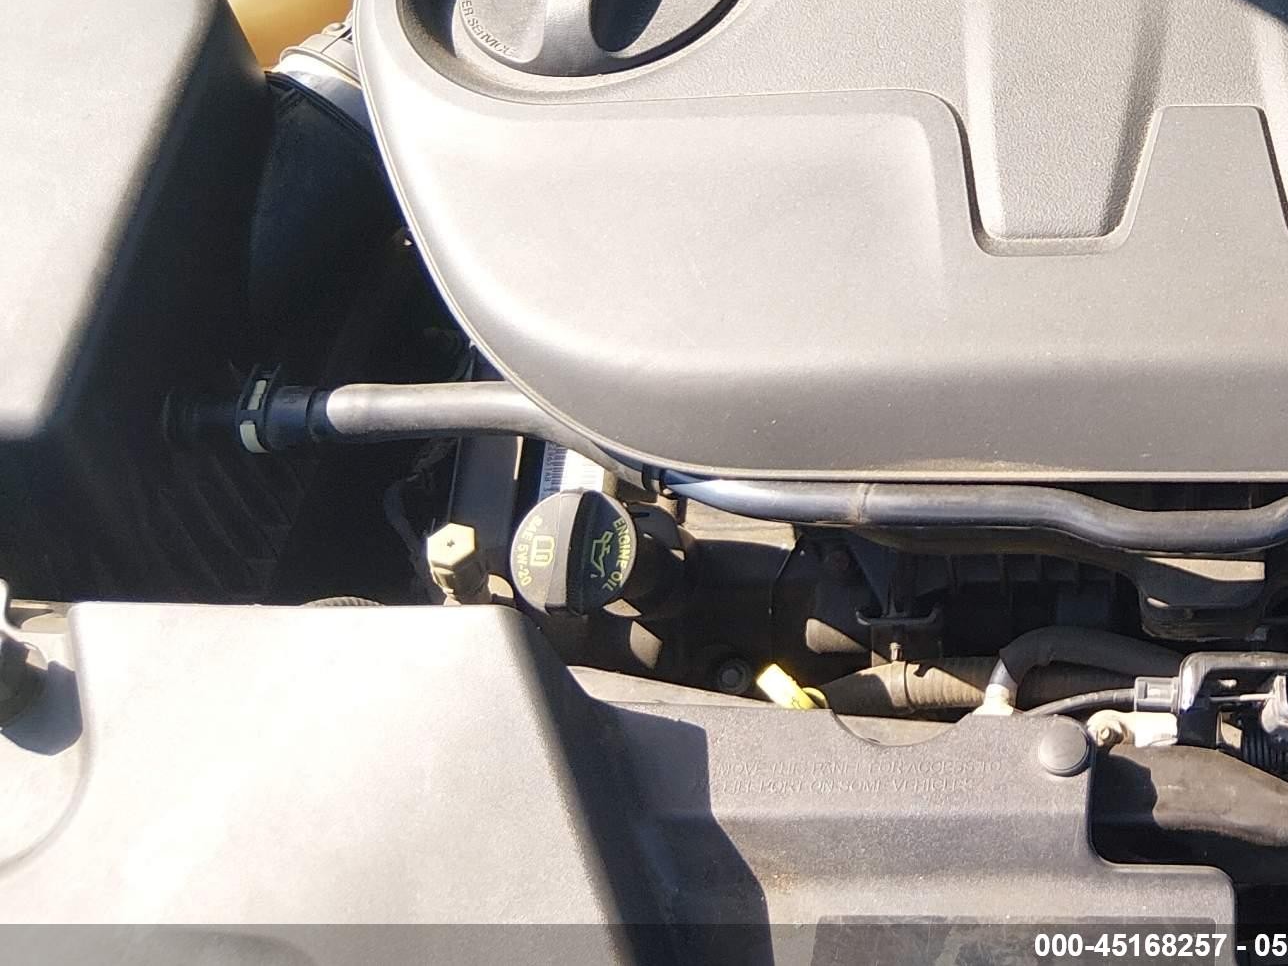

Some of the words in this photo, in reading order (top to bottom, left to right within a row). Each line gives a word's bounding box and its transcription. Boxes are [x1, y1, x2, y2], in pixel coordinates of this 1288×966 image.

[467, 18, 516, 57] SERVICE
[520, 515, 544, 544] SAE
[612, 517, 632, 568] ENGINE
[516, 545, 533, 587] 5W-20
[602, 570, 623, 592] OIL
